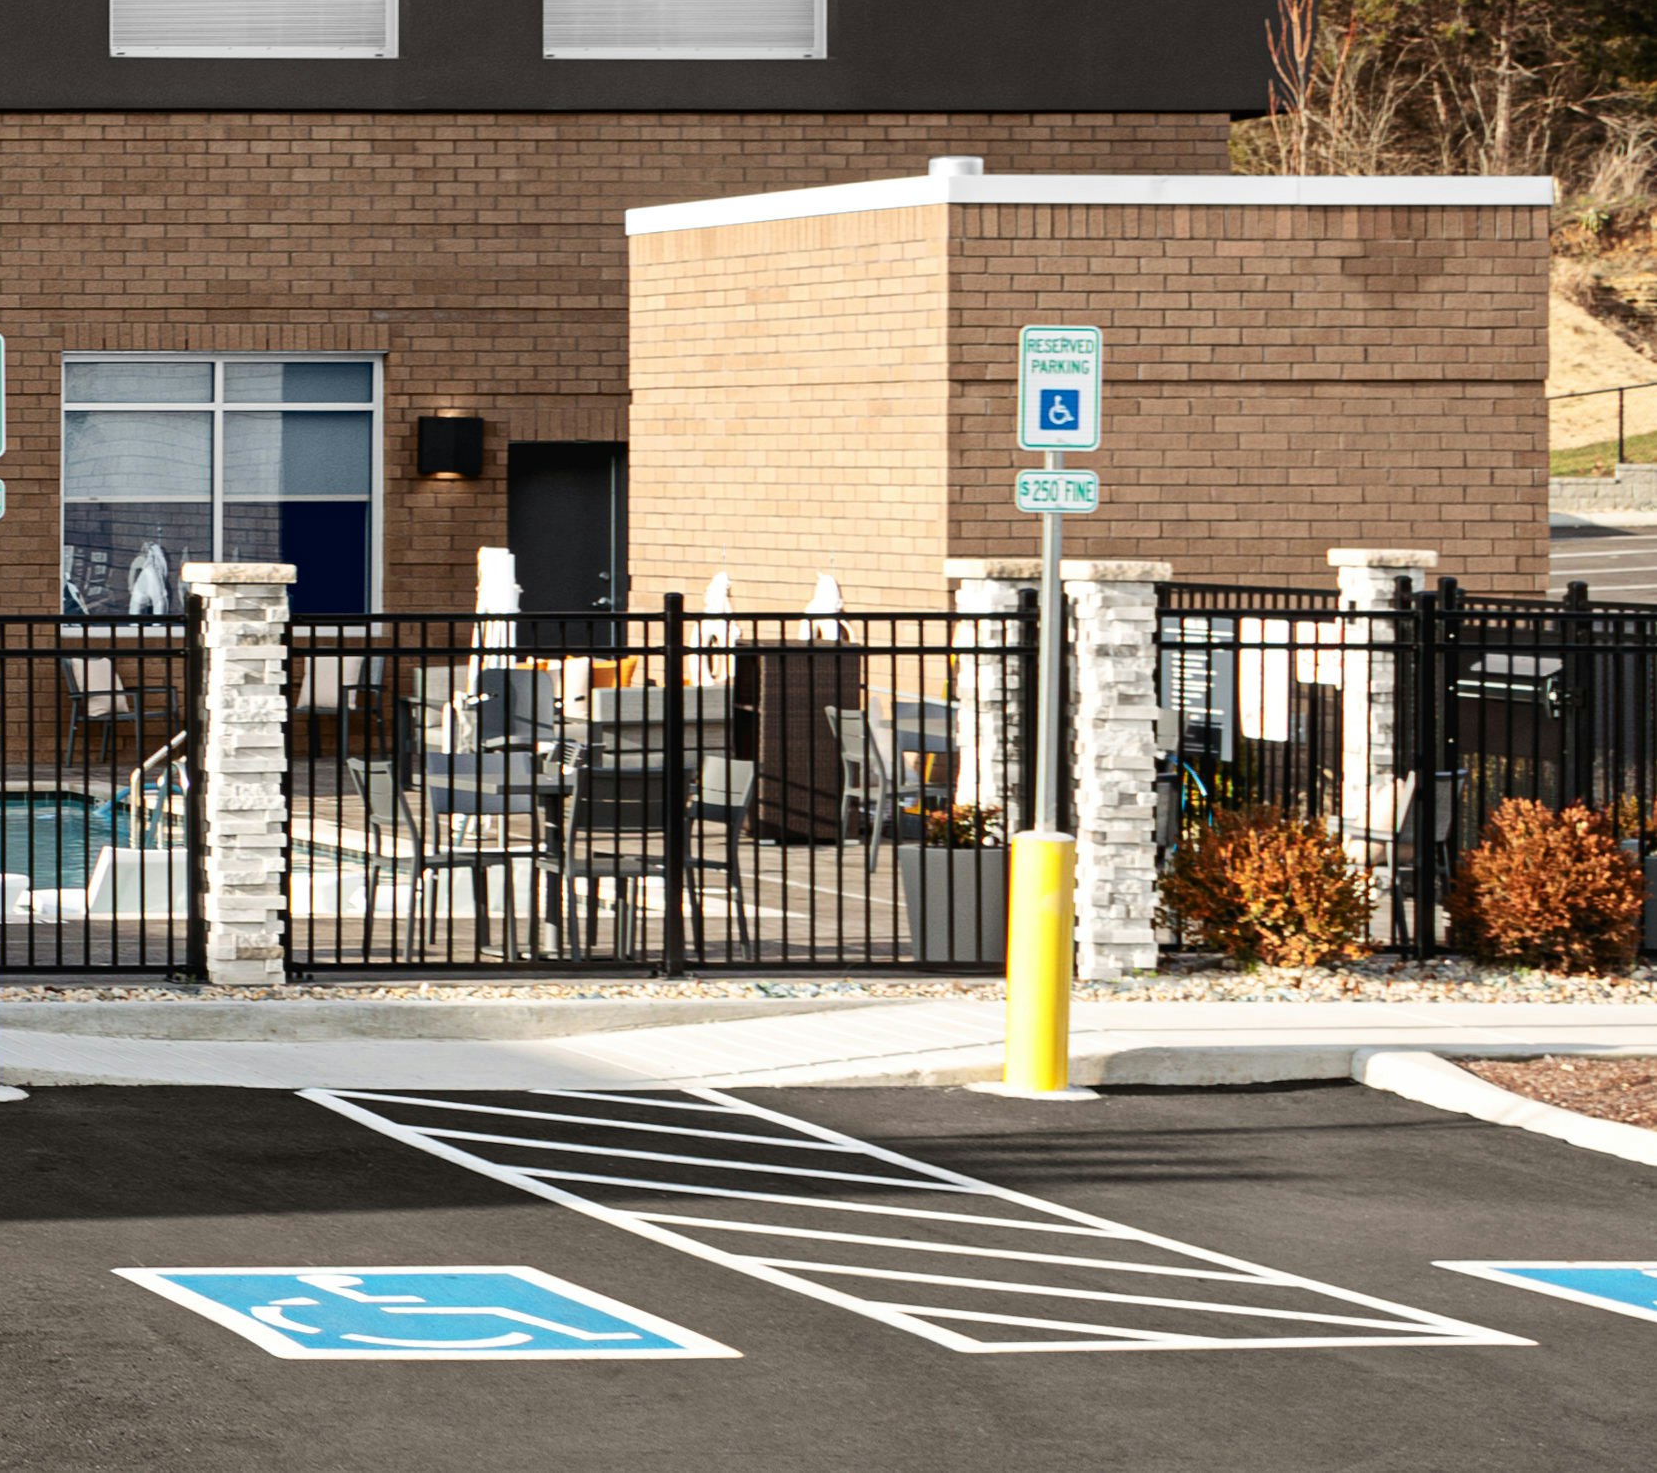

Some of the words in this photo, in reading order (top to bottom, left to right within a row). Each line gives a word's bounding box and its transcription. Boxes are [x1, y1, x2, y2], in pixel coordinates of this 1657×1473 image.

[1027, 338, 1094, 353] RESERVED
[1031, 359, 1090, 375] PARKING
[1064, 480, 1095, 502] FINE
